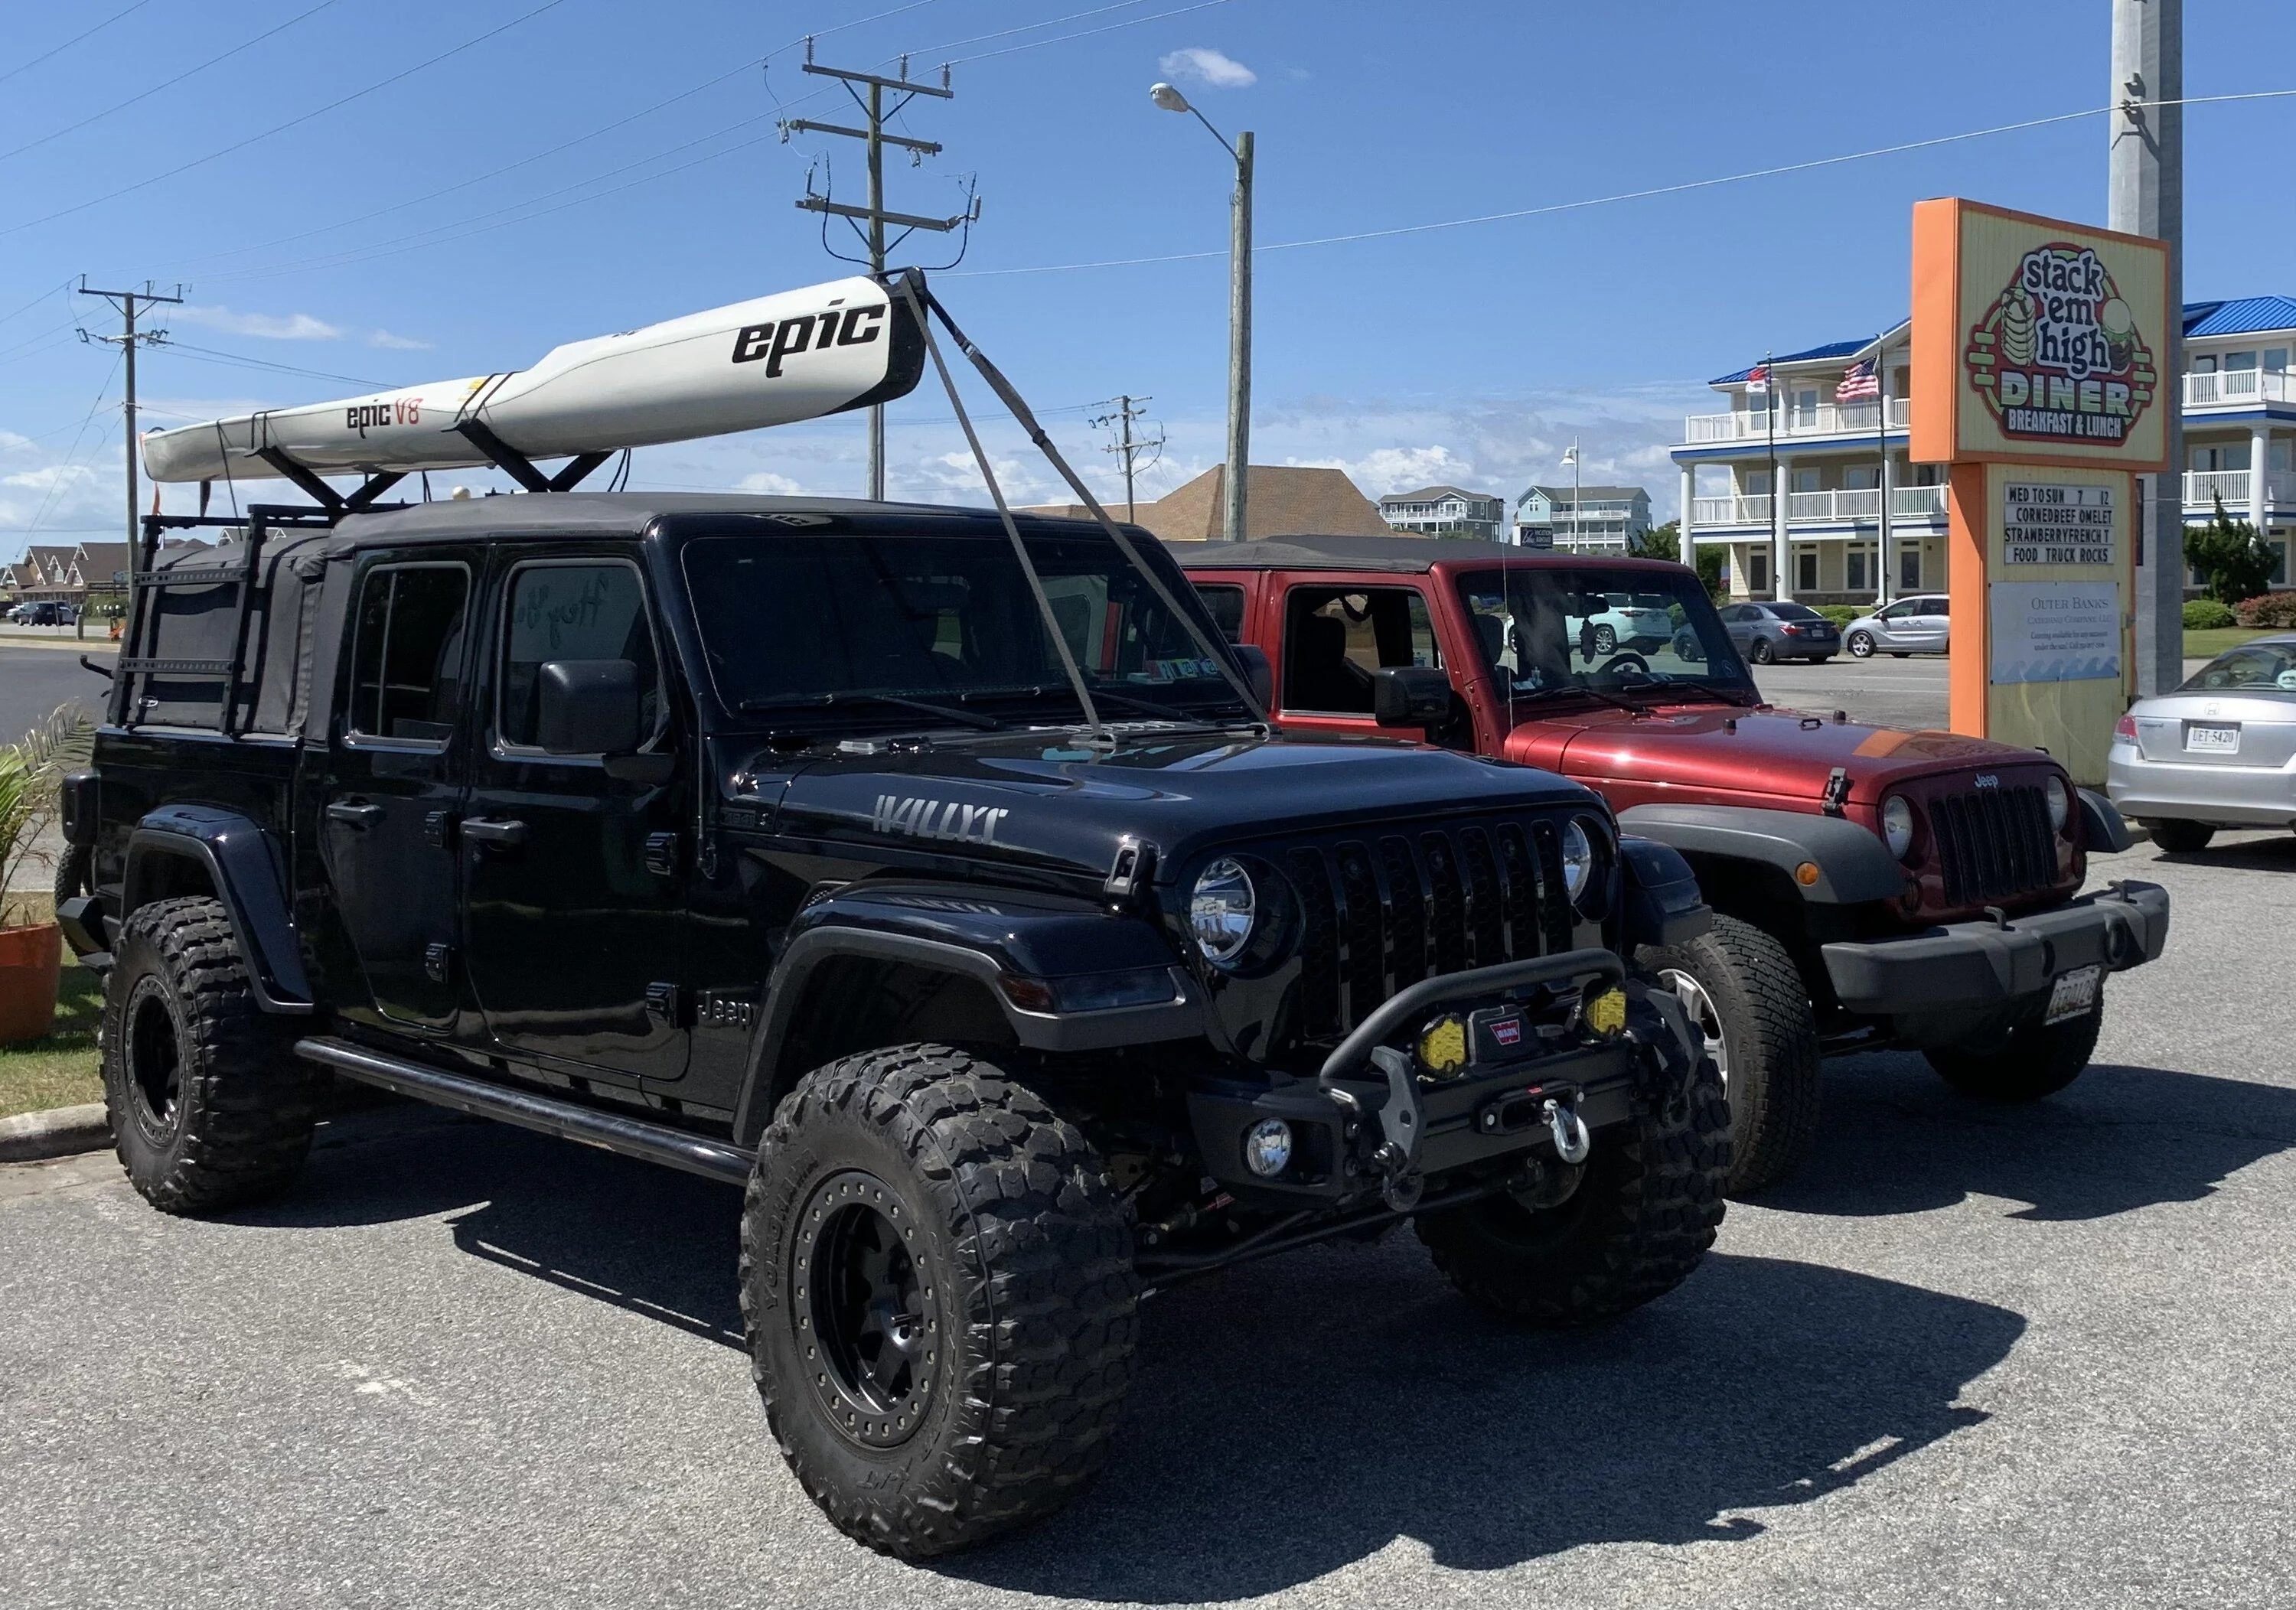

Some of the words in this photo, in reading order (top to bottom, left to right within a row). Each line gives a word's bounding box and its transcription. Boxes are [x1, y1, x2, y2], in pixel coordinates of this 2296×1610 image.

[2027, 255, 2101, 297] stack
[732, 298, 886, 379] epic
[2040, 321, 2108, 374] high
[2001, 371, 2130, 416] DINER
[347, 398, 391, 439] epic
[2008, 408, 2073, 434] BREAKFAST
[2076, 414, 2083, 435] &
[2086, 415, 2122, 438] LUNCH
[2009, 487, 2030, 502] WED
[2077, 490, 2083, 504] 7
[2100, 490, 2109, 505] 12
[2079, 509, 2112, 524] OMELET
[2103, 529, 2109, 543] T
[2014, 548, 2037, 562] FOOD
[2046, 548, 2075, 562] TRUCK
[2079, 548, 2108, 562] ROCKS
[2031, 597, 2069, 610] OUTER
[2072, 596, 2109, 609] BANKS
[1975, 773, 1998, 788] Jeep
[697, 990, 751, 1031] Jeep
